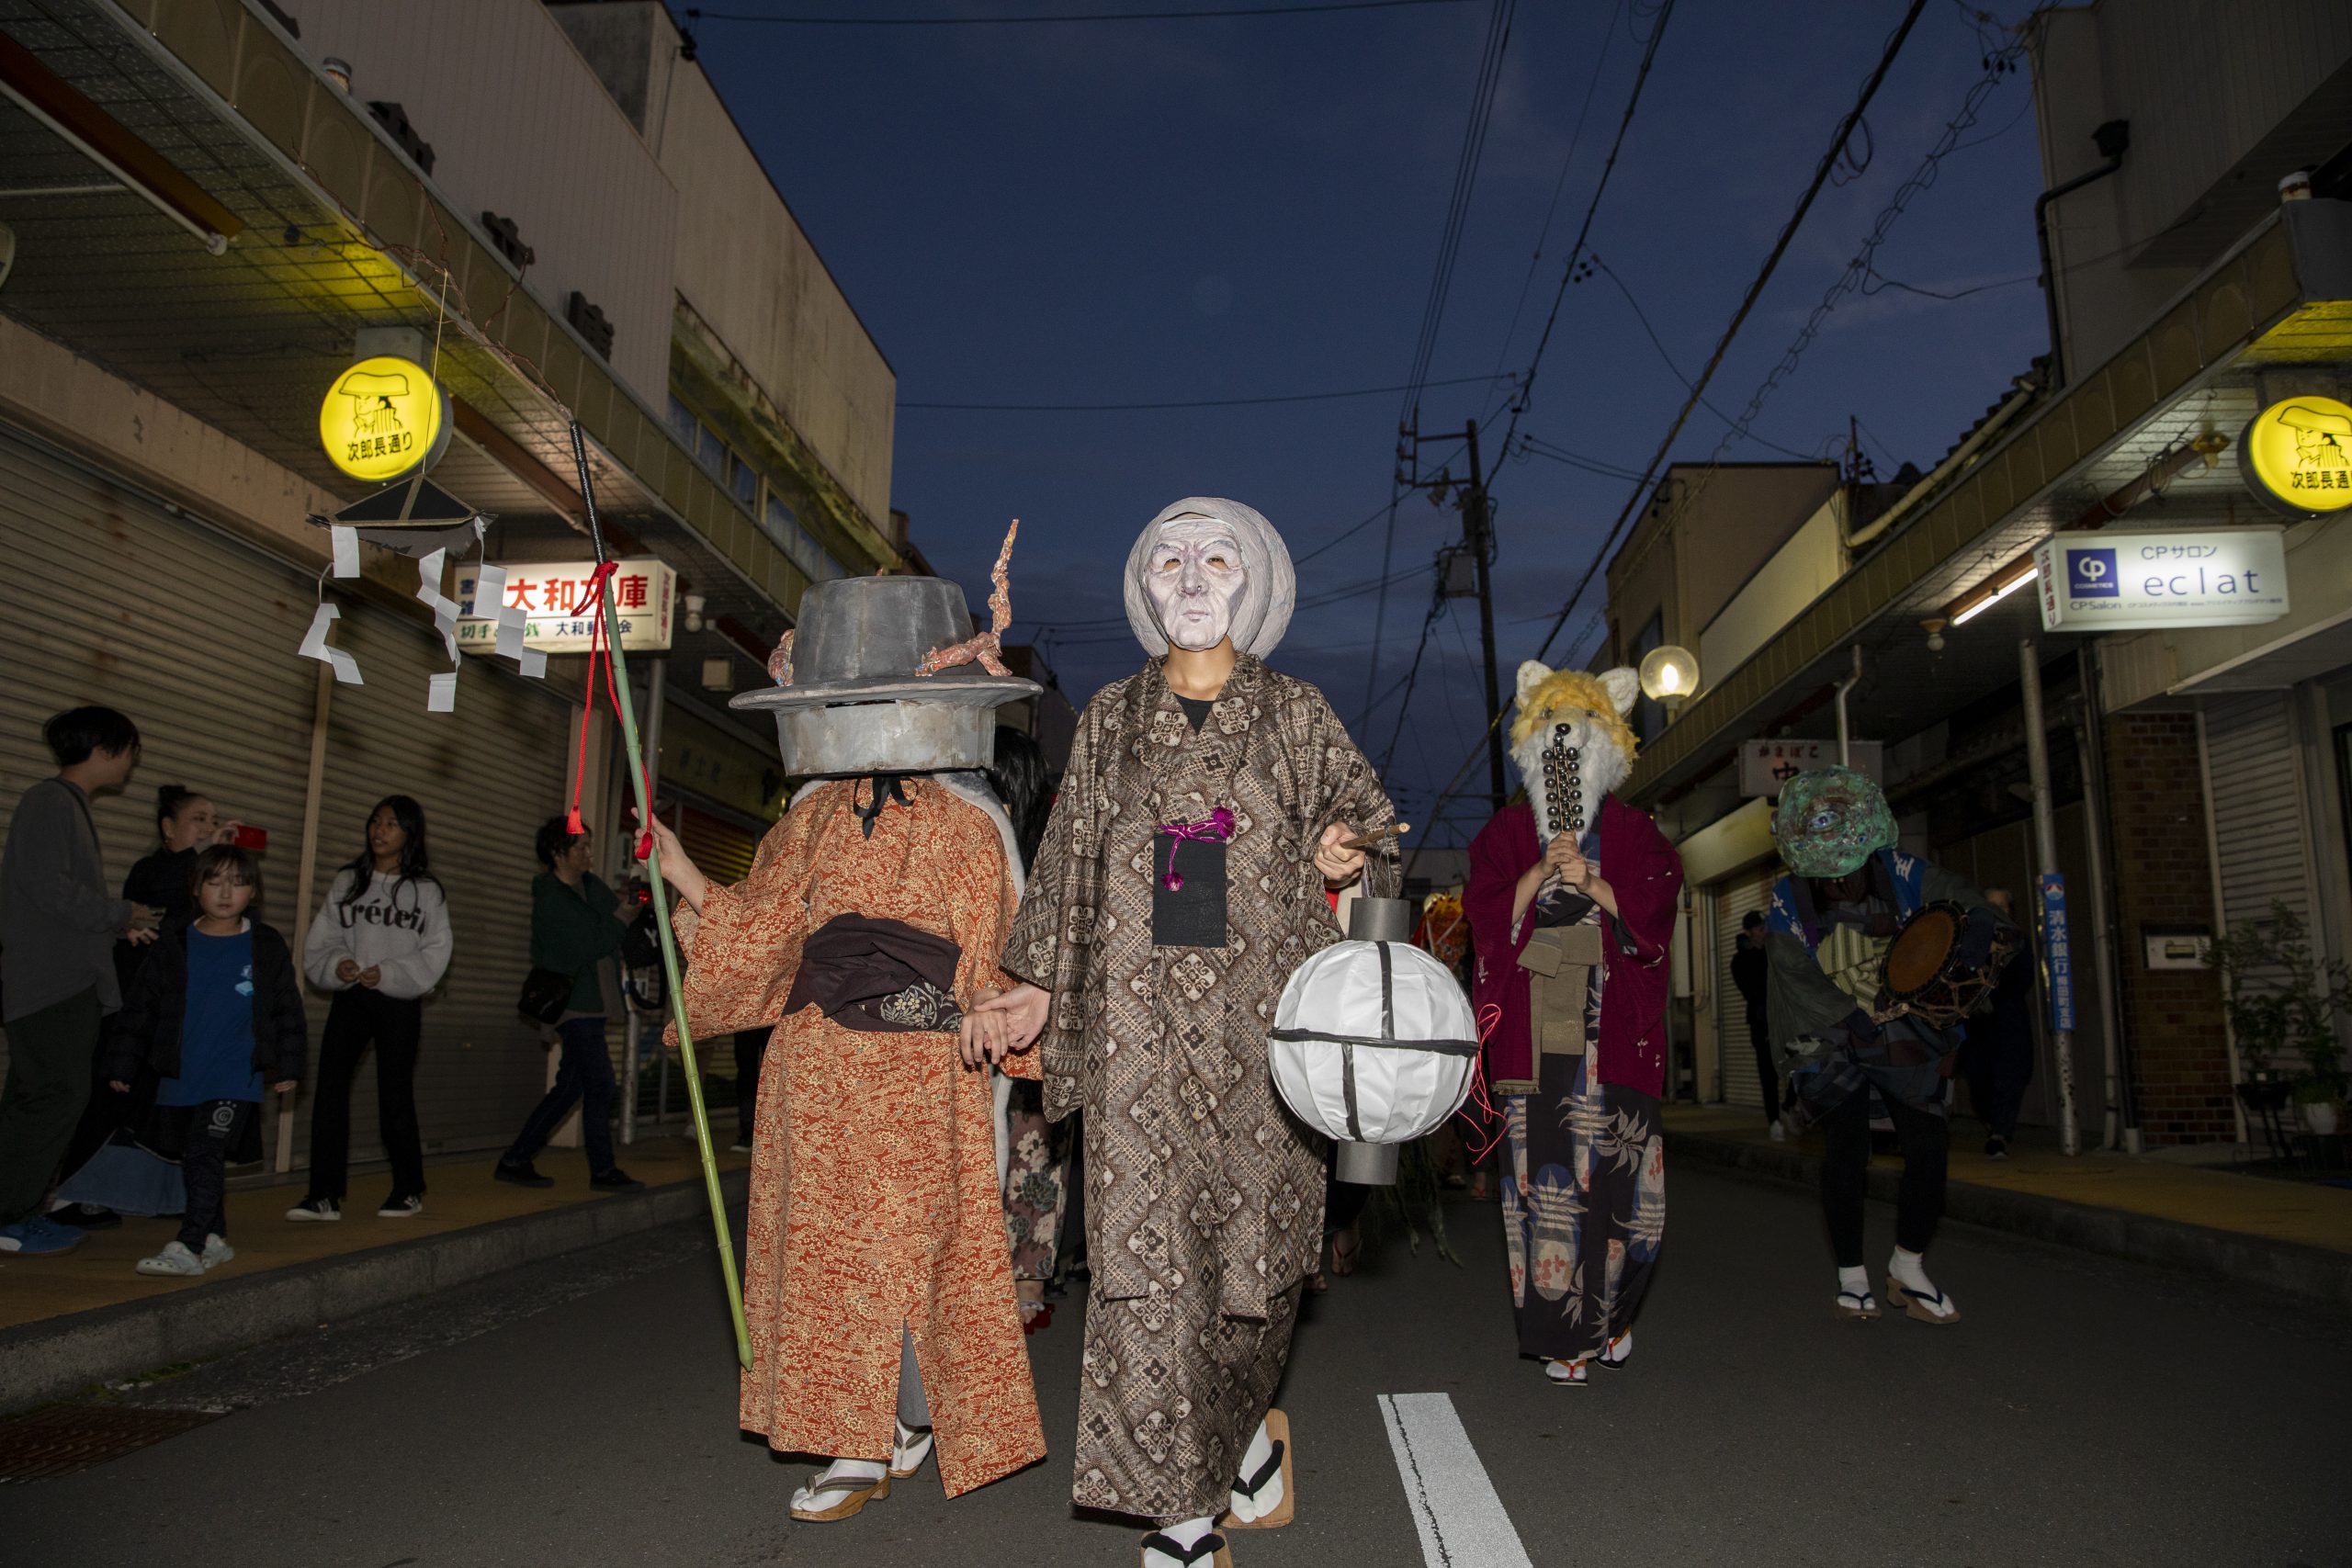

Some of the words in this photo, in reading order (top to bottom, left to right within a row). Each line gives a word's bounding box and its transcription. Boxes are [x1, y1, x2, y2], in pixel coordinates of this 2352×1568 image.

[347, 432, 413, 462] 次郎長通り
[2290, 470, 2352, 490] 次郎長通
[2141, 546, 2217, 559] CPサロン
[2144, 567, 2259, 596] eclat
[556, 619, 632, 637] 大和郵会
